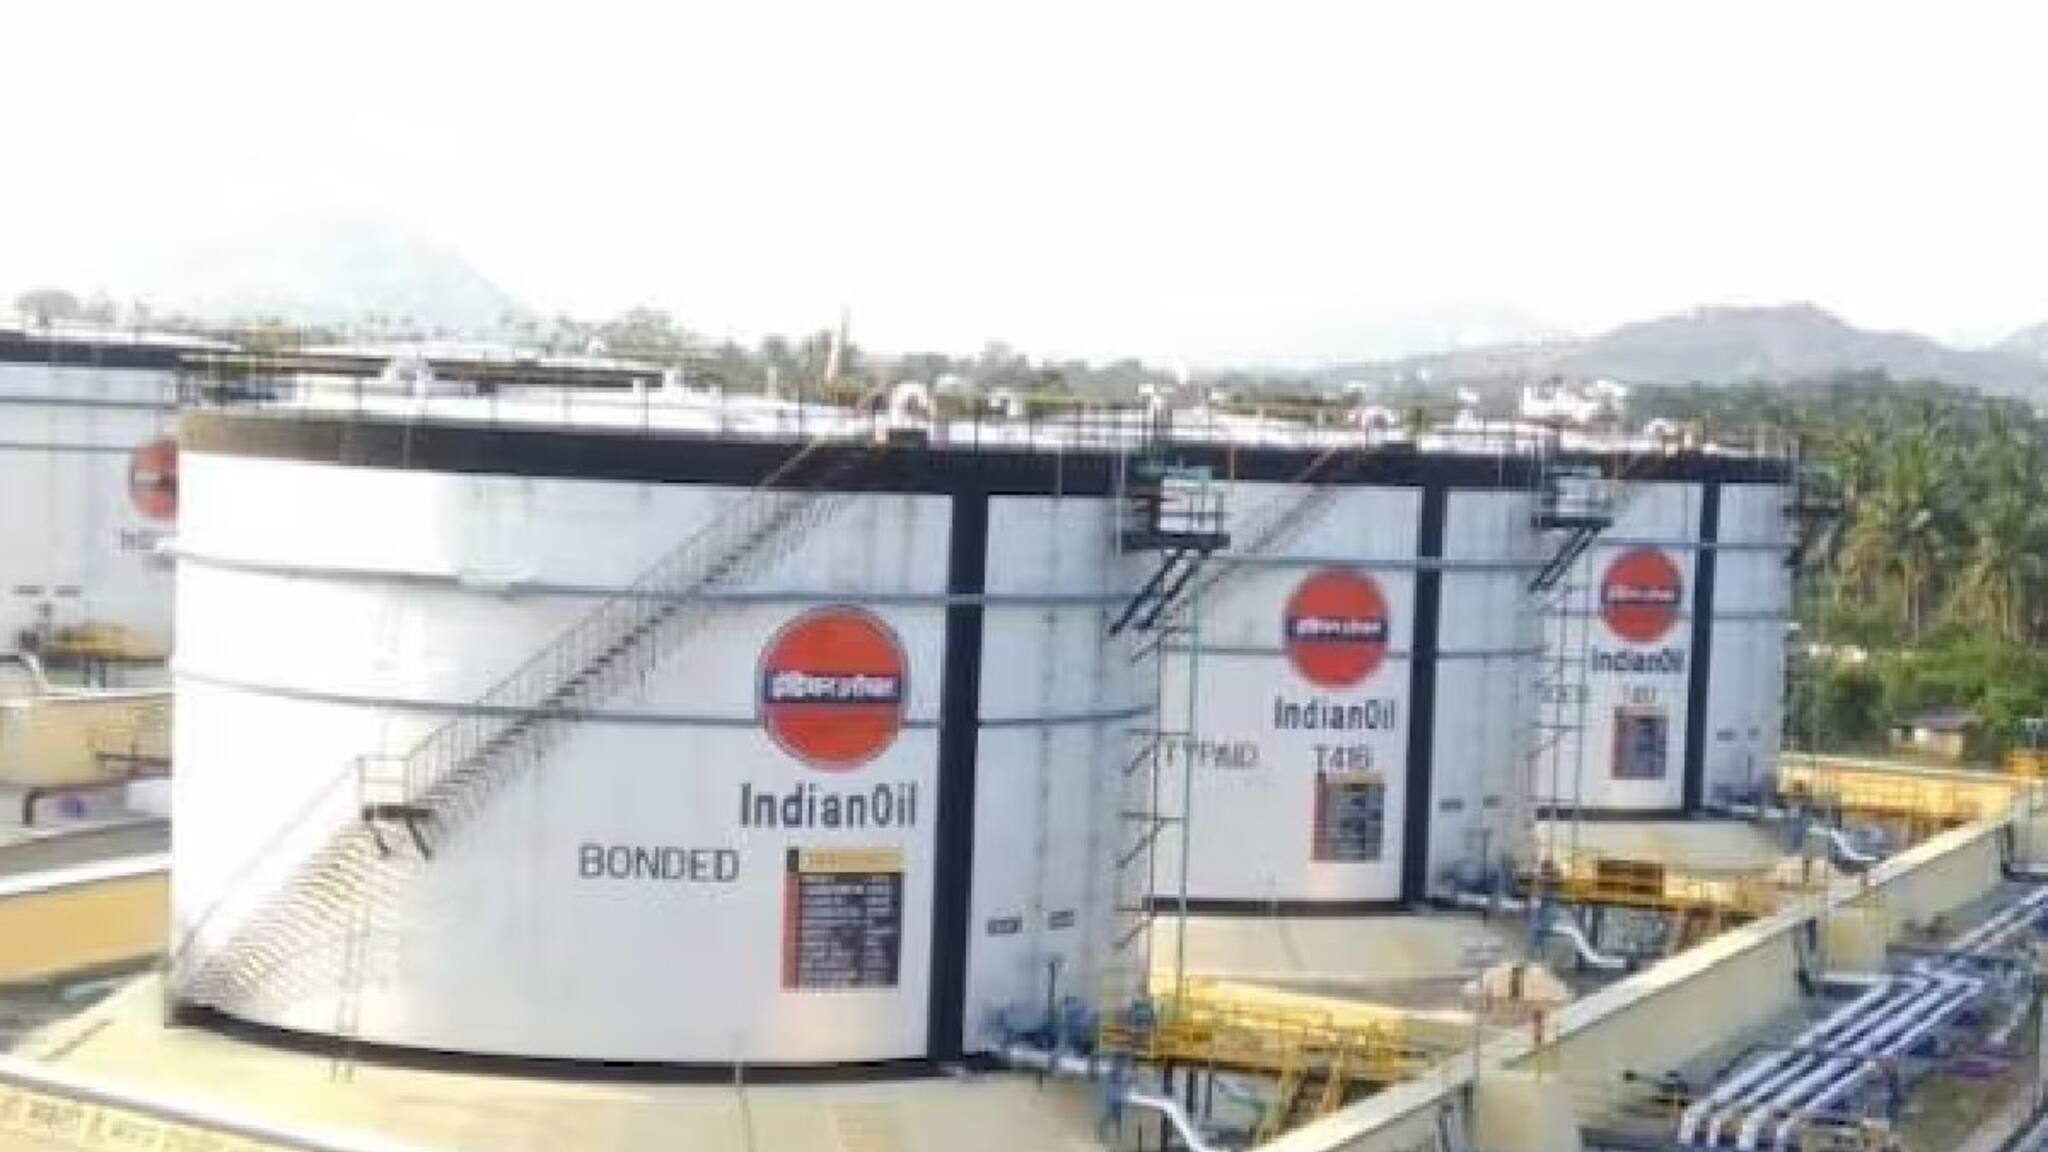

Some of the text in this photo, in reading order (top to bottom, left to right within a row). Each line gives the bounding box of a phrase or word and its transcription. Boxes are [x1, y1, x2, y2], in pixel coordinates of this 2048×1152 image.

[1273, 697, 1395, 730] IndianOil
[739, 782, 917, 829] IndianOil
[578, 844, 740, 882] BONDED
